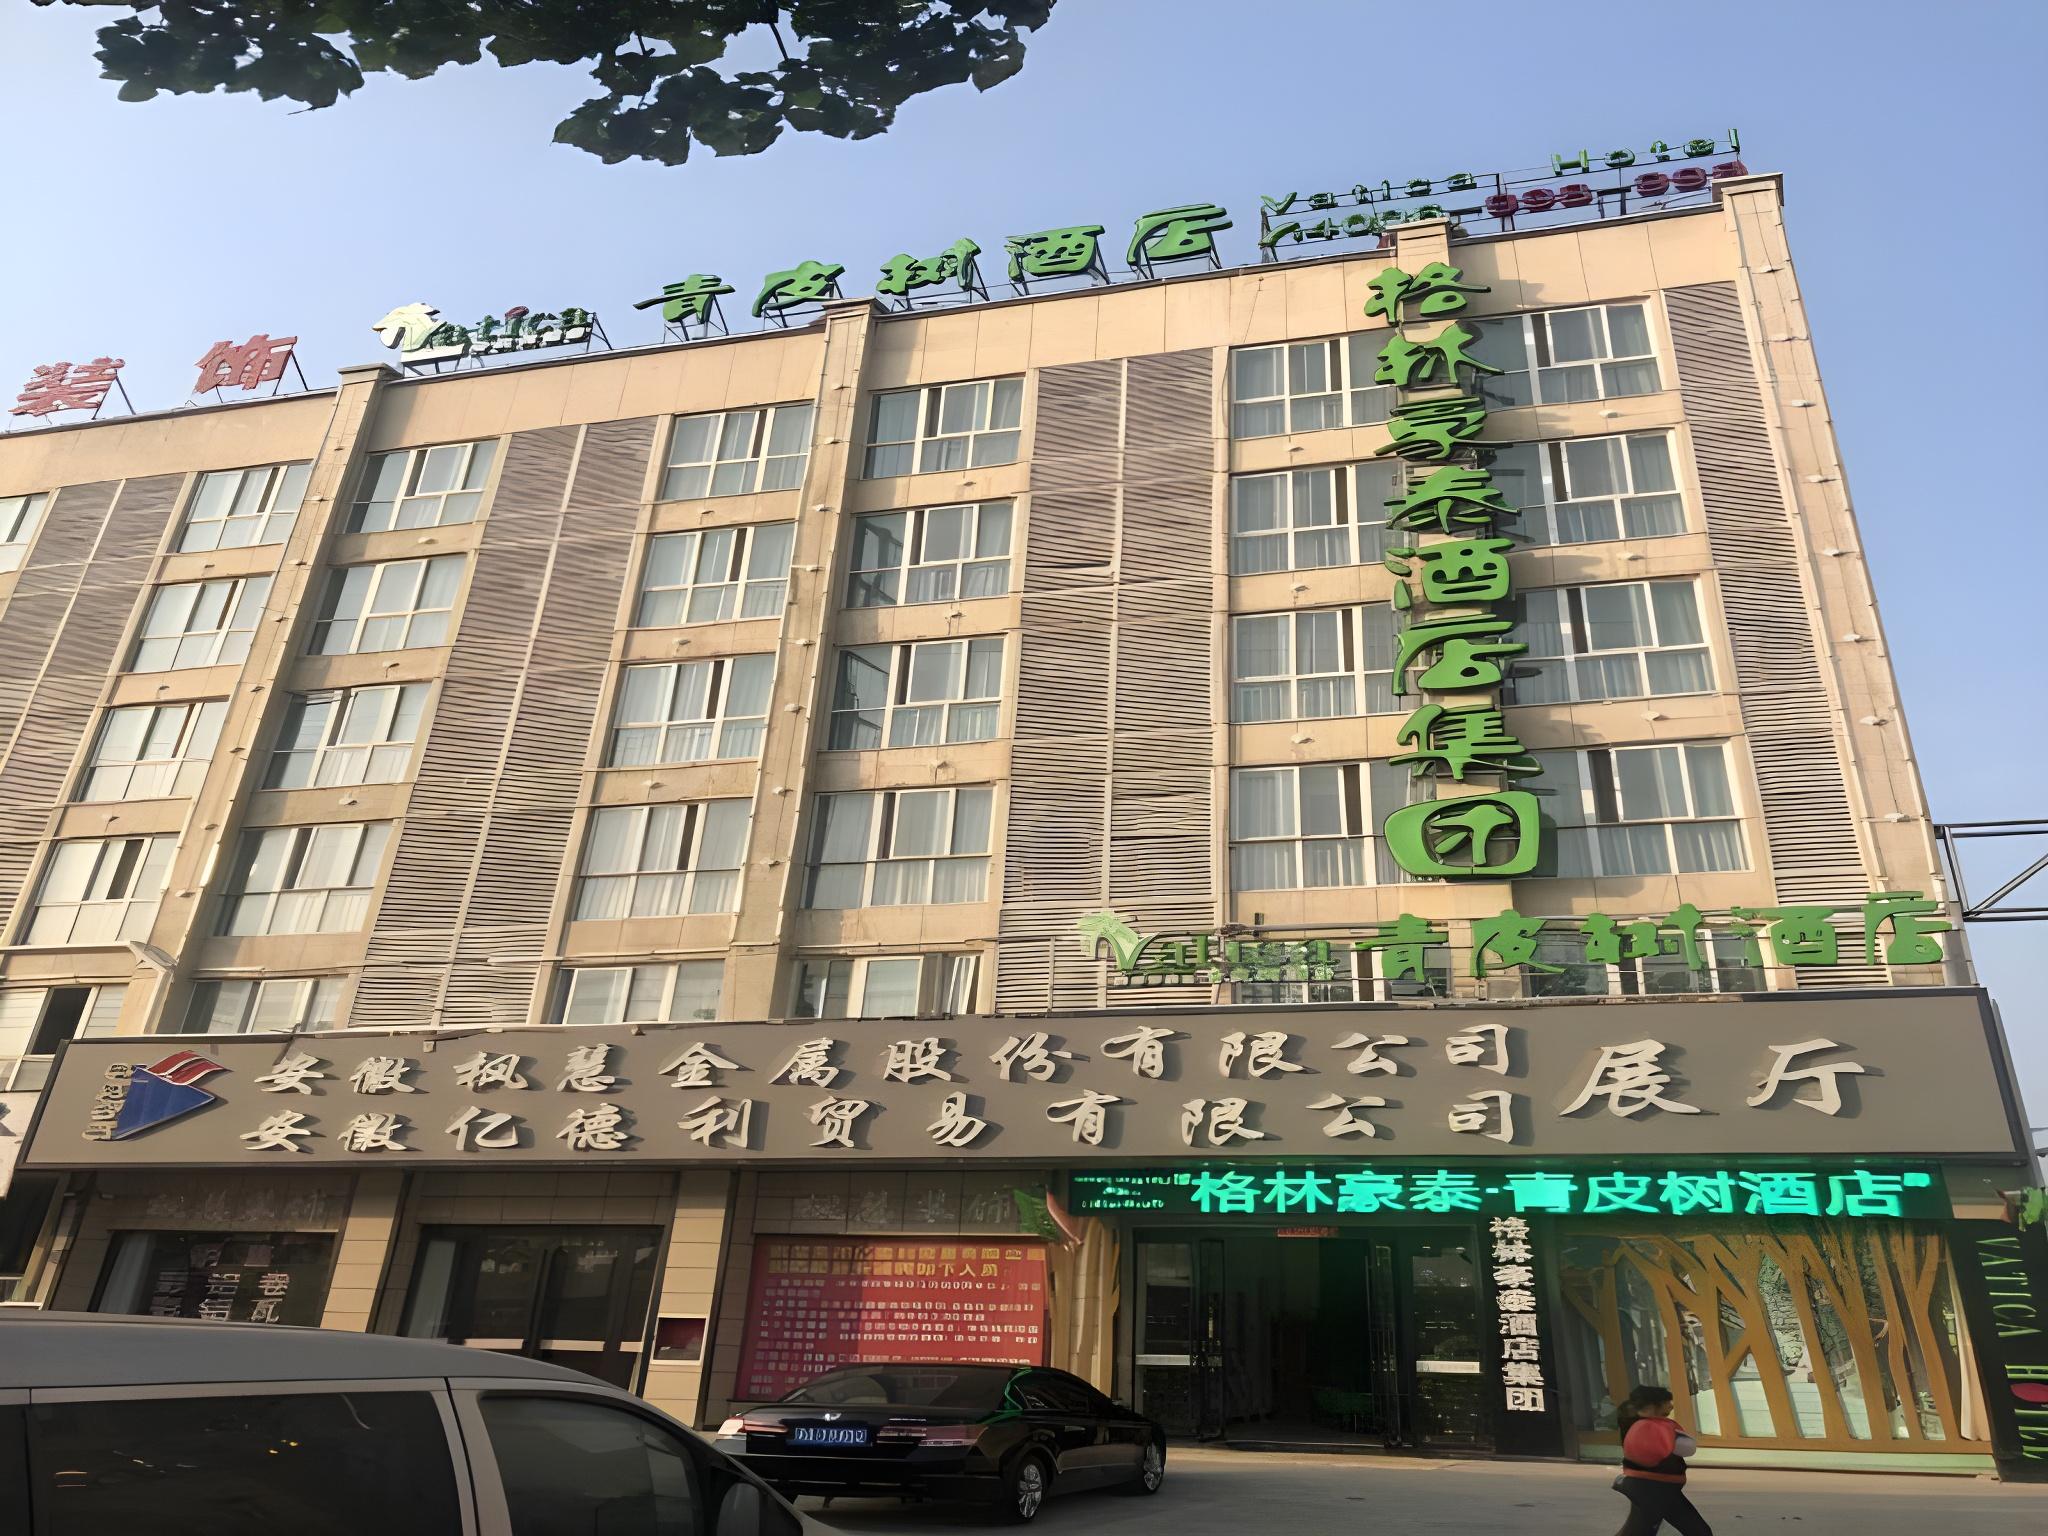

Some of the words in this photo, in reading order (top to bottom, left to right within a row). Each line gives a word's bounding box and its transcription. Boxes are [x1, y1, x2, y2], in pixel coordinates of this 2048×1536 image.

[1551, 128, 1740, 176] Hotel
[633, 203, 1233, 323] 青皮树酒店
[1364, 262, 1543, 877] 格林豪泰酒店集团
[1354, 891, 1952, 983] 青皮树酒店
[254, 1023, 1509, 1095] 安徽枫慧金属股份有限公司
[1559, 1039, 1866, 1117] 展厅
[240, 1089, 1515, 1153] 安徽亿德利贸易有限公司
